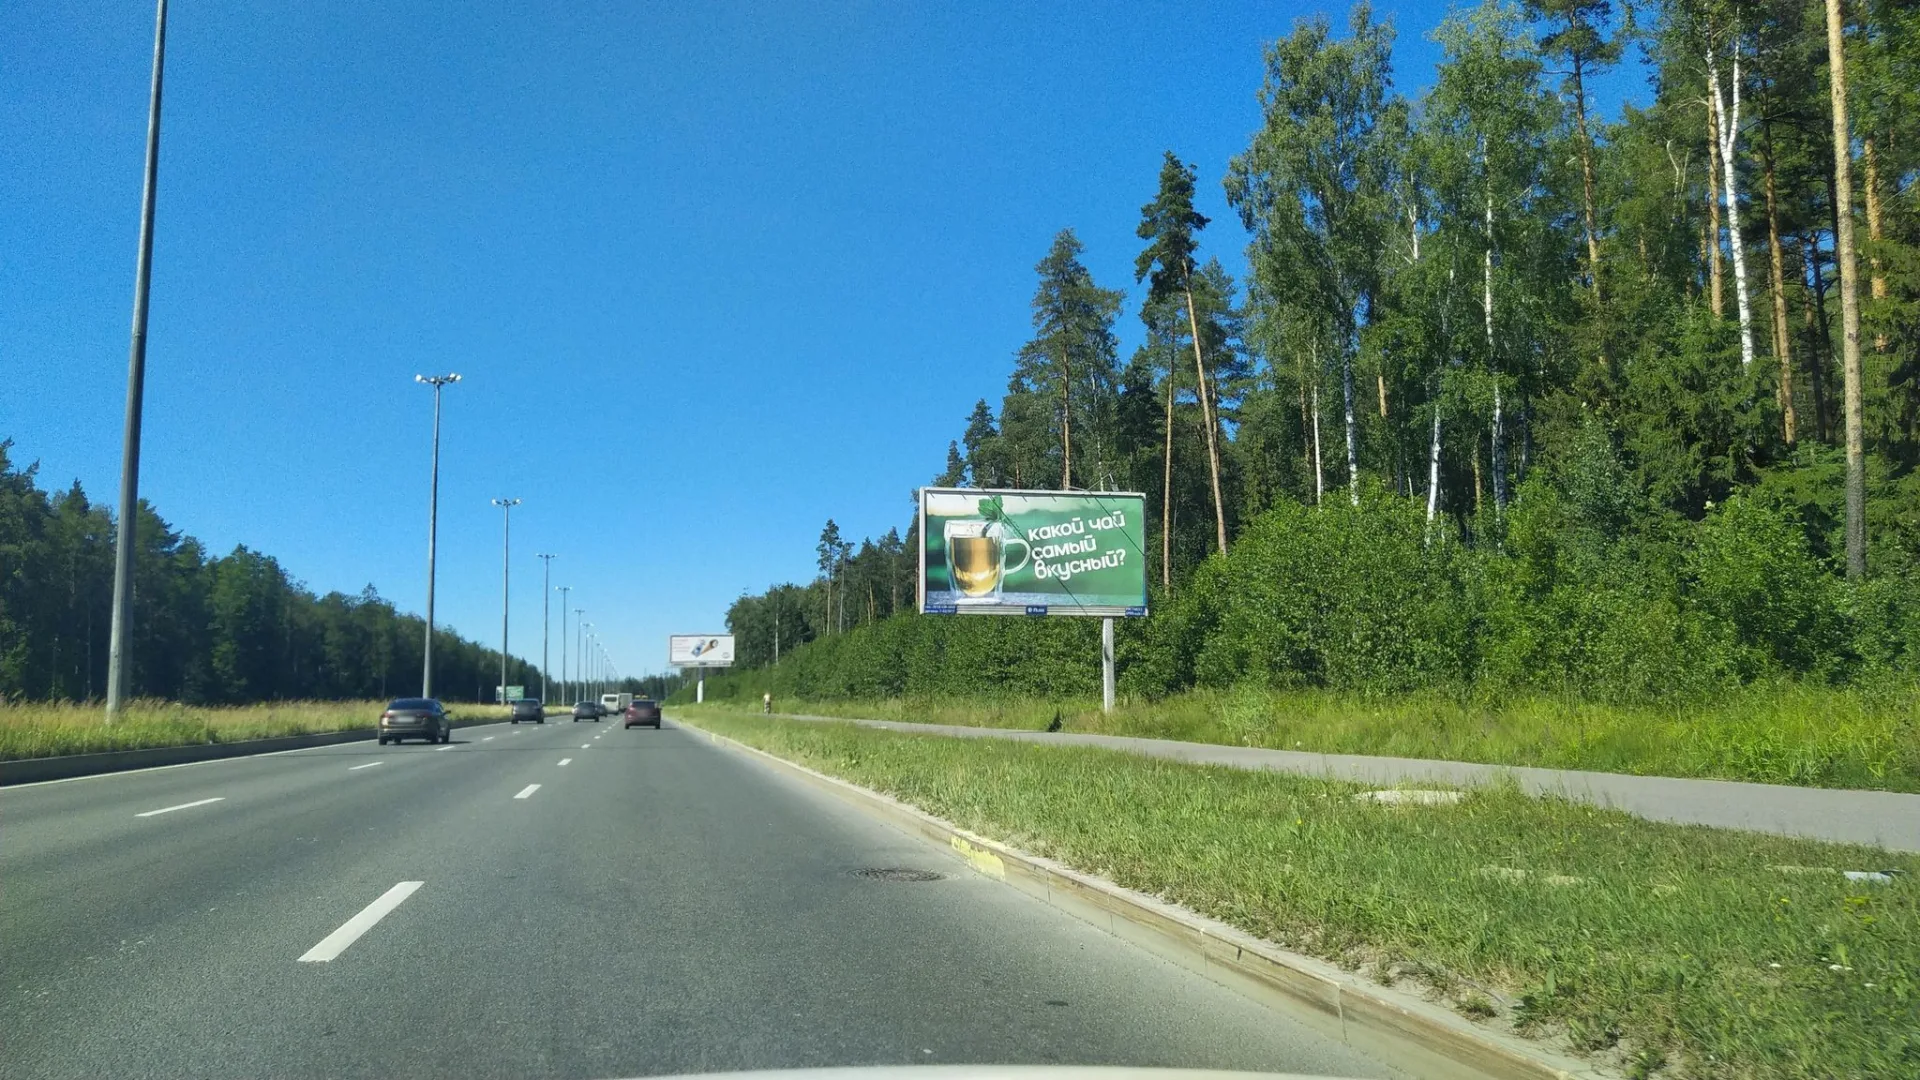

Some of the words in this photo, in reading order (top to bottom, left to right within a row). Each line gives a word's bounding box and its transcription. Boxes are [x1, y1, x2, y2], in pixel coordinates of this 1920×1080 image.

[1028, 517, 1084, 541] какой
[1088, 511, 1125, 530] чай
[1032, 534, 1097, 560] самый
[1034, 549, 1126, 581] вкусный?
